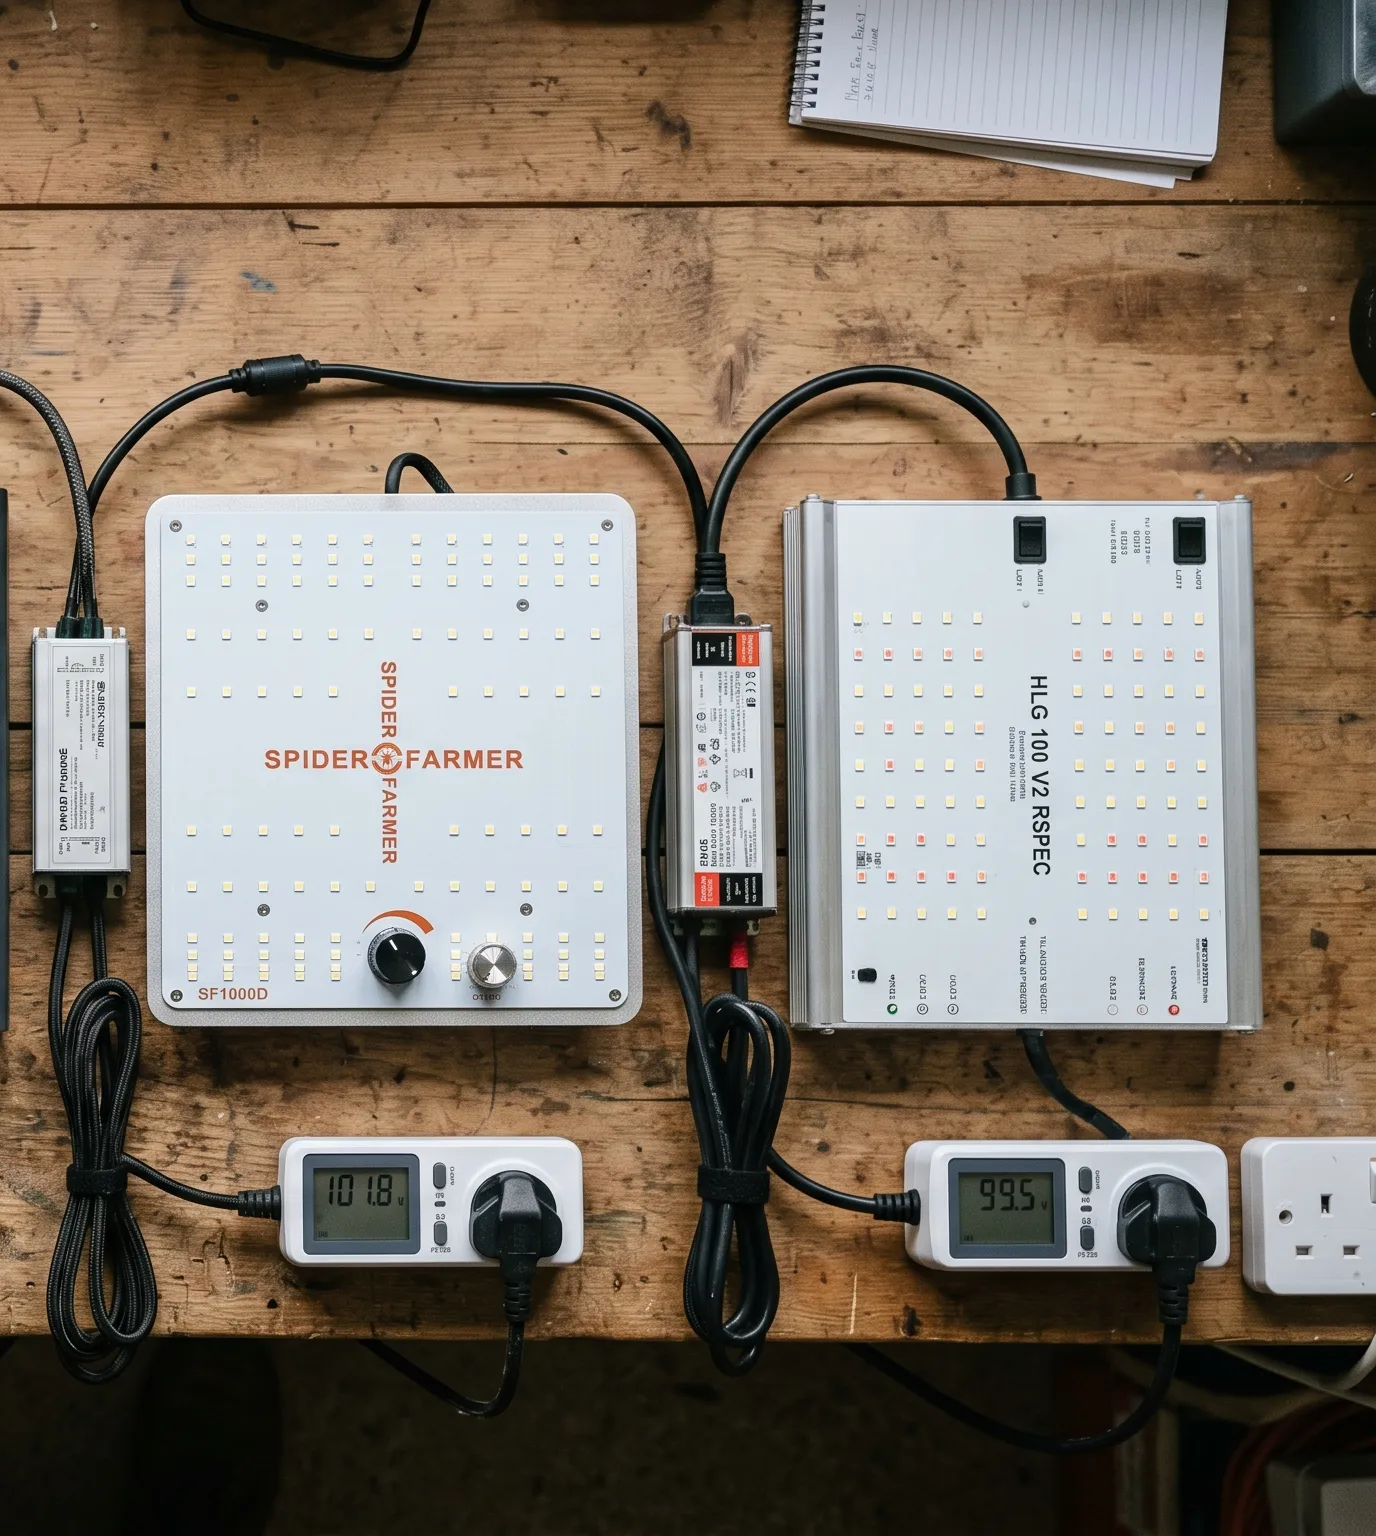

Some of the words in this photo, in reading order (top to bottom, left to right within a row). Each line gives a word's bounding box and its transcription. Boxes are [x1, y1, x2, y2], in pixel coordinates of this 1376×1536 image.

[380, 661, 397, 738] SPIDER
[1030, 675, 1049, 720] HLG
[264, 749, 369, 769] SPIDER
[405, 749, 524, 769] FARMER
[1030, 728, 1049, 763] 100
[1031, 770, 1049, 798] V2
[381, 777, 398, 864] FARMER
[1032, 805, 1051, 876] RSPEC
[198, 986, 269, 1001] SF1000D
[328, 1174, 393, 1206] 101.8
[980, 1178, 1036, 1211] 99.5
